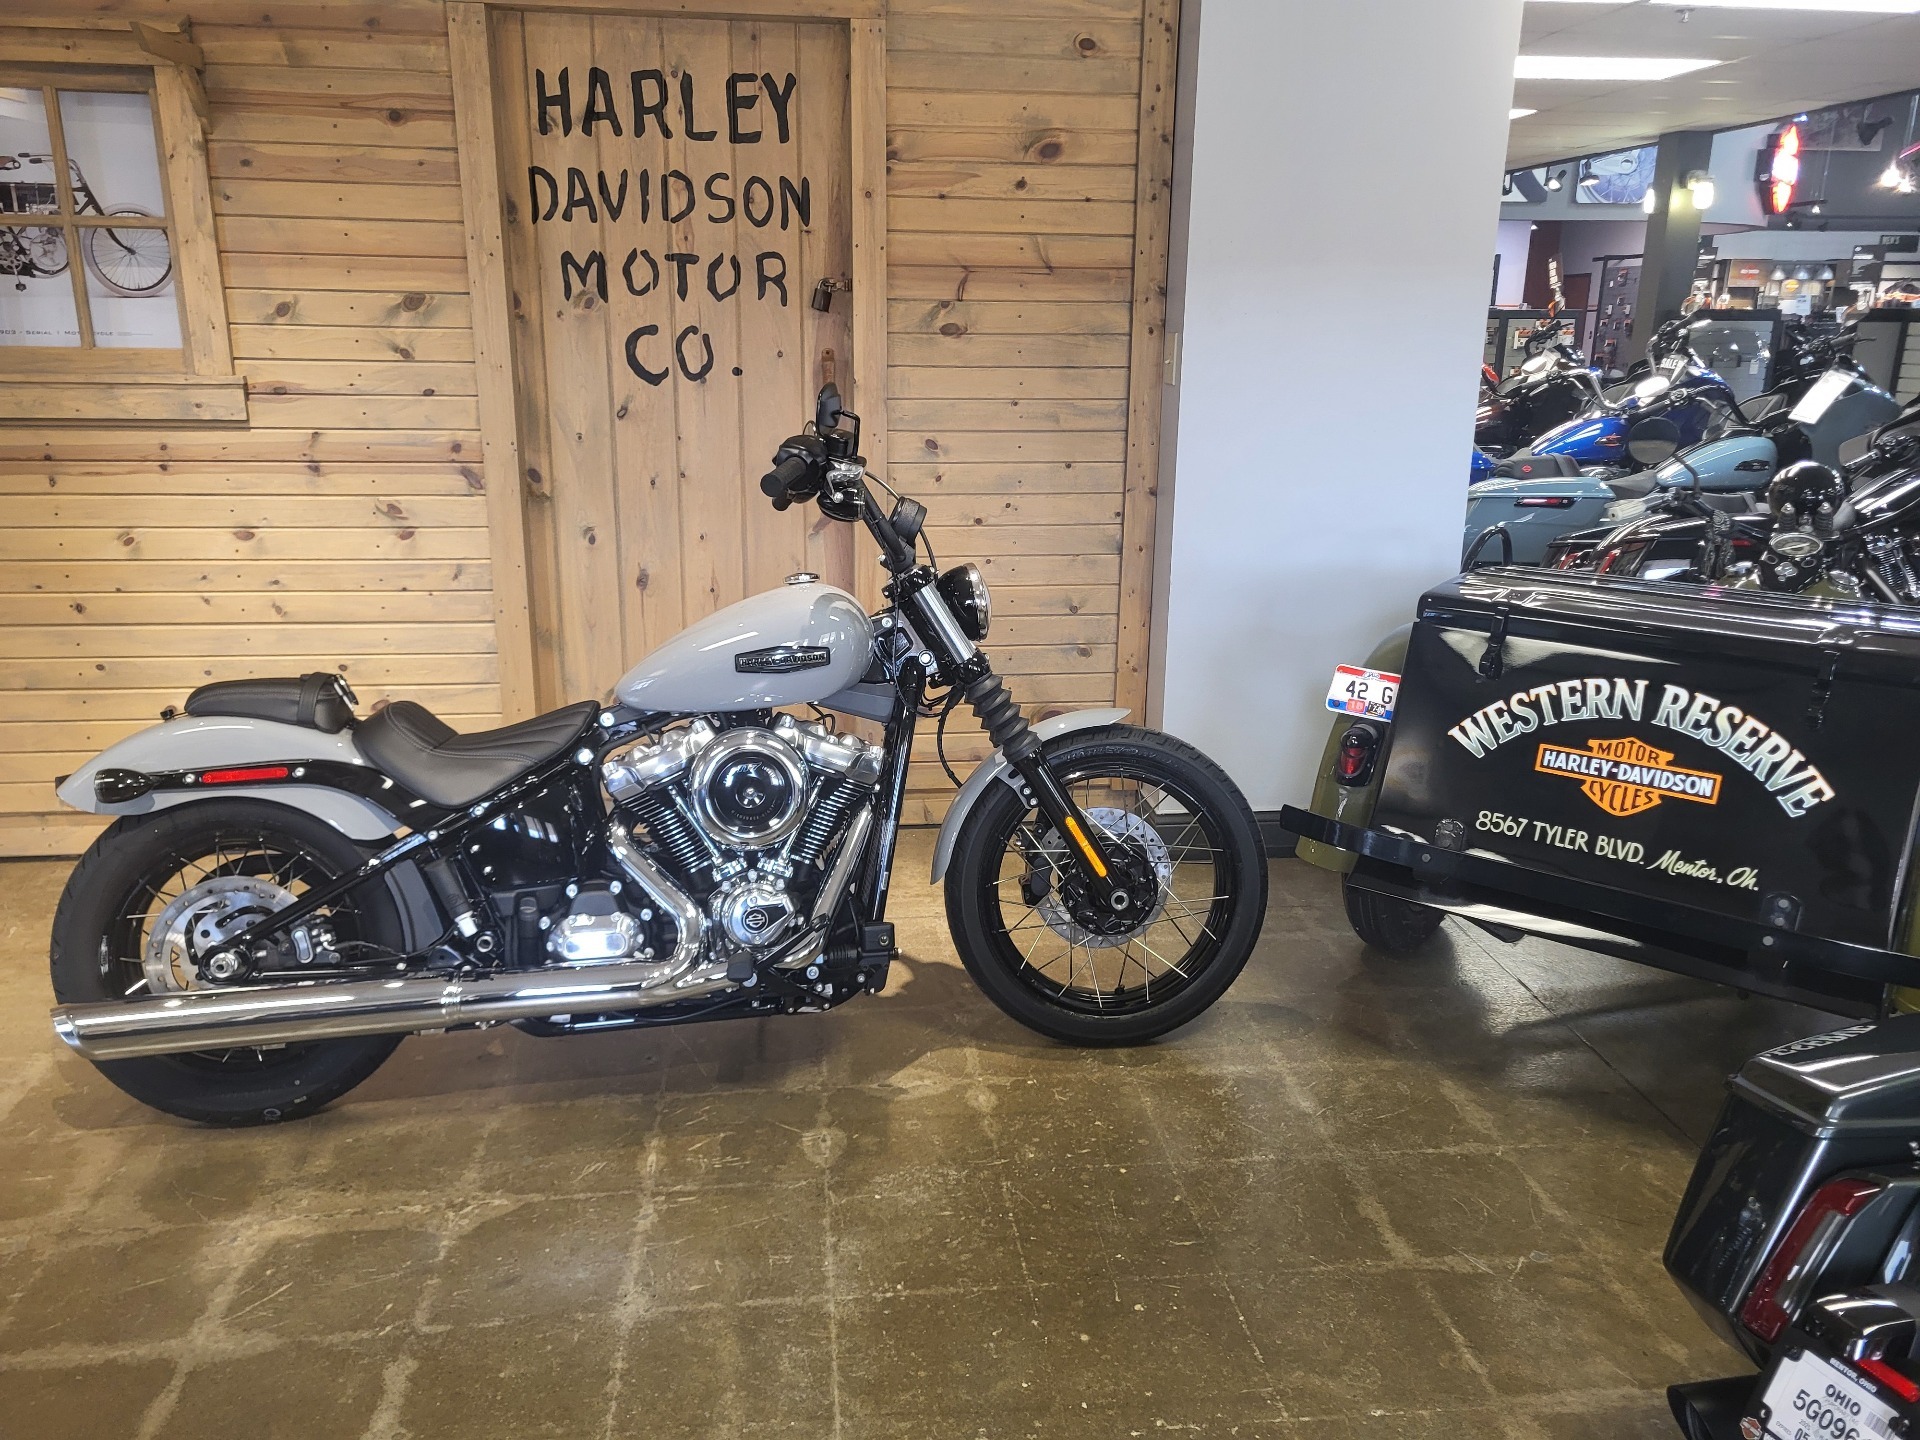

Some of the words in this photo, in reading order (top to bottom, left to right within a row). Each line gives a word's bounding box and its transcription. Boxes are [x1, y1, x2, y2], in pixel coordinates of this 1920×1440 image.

[535, 66, 797, 144] HARLEY
[527, 165, 811, 231] DAVIDSON
[560, 247, 788, 307] MOTOR
[624, 324, 743, 387] CO.
[1660, 357, 1679, 370] SALE
[1345, 680, 1369, 701] 42
[1381, 686, 1394, 705] G
[1447, 677, 1650, 760] WESTERN
[1651, 683, 1836, 819] RESERVE
[1541, 749, 1715, 798] HARLEY-DAVIDSON
[1595, 739, 1661, 766] MOTOR
[1588, 780, 1656, 813] CYCLES
[1475, 809, 1527, 839] 8567
[1532, 820, 1590, 854] TYLER
[1595, 833, 1645, 866] BLVD.
[1646, 849, 1724, 885] Mentor,
[1725, 865, 1760, 892] Oh.
[1825, 1384, 1861, 1416] OHIO
